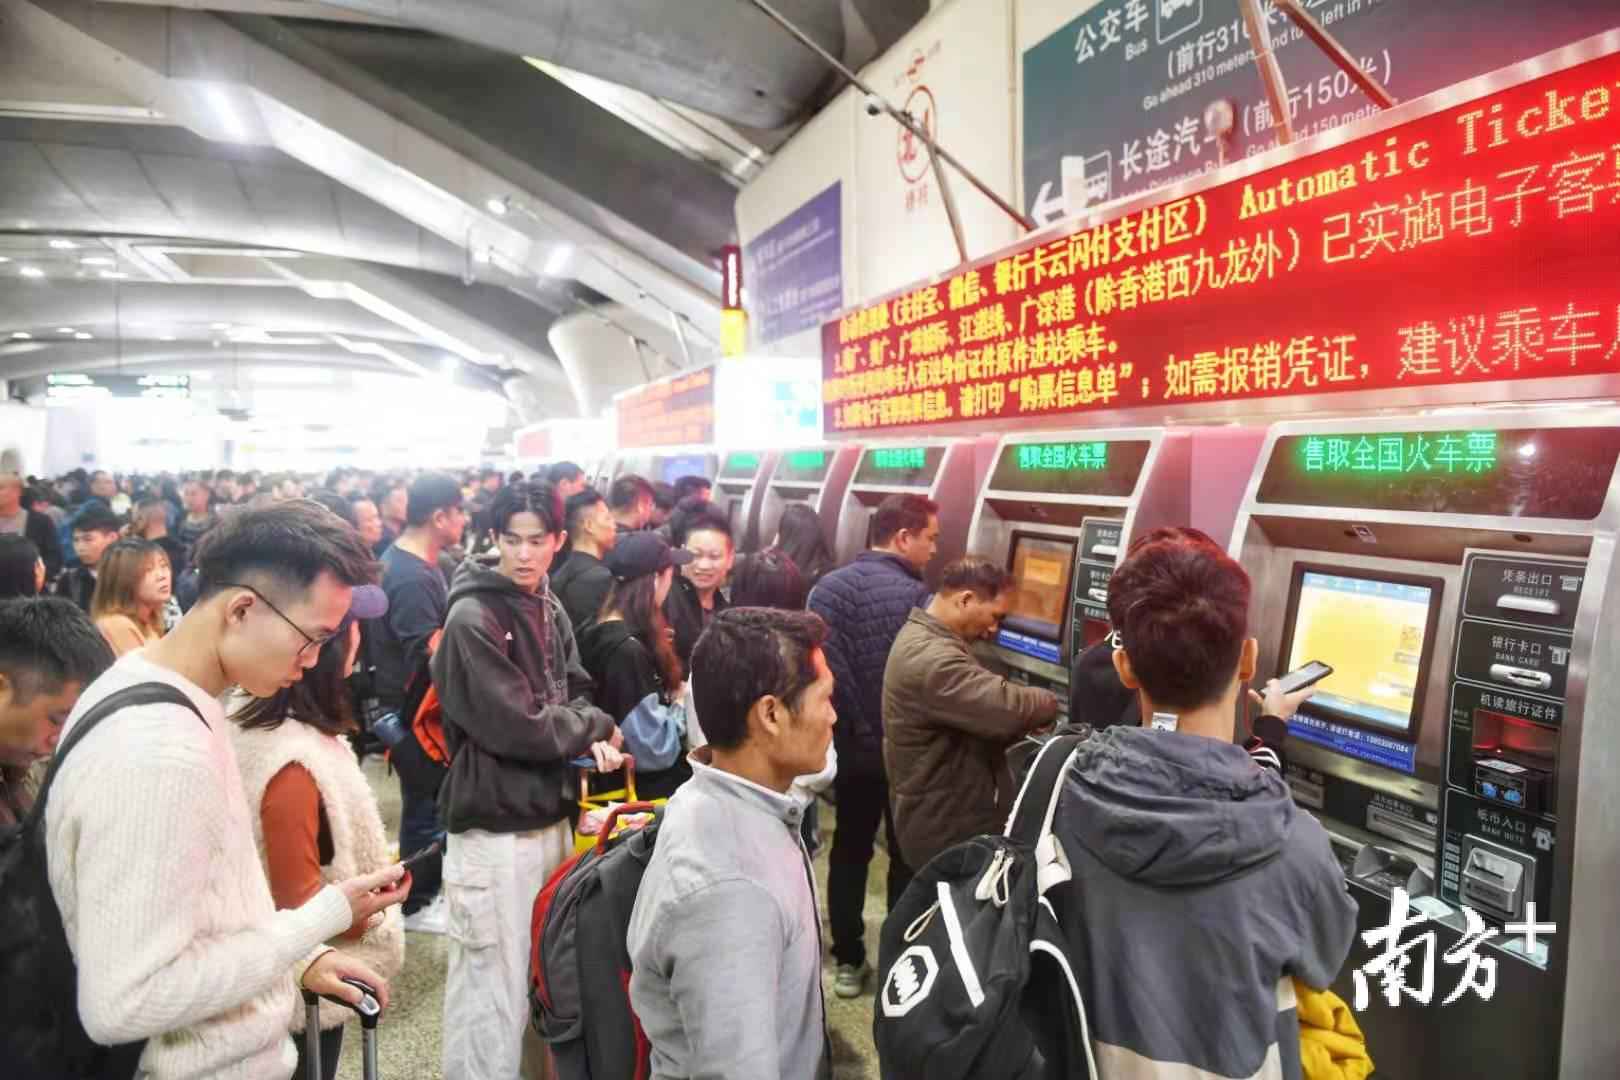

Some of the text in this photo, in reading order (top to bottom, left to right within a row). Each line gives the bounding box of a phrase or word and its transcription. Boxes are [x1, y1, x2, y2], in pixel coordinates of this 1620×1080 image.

[1074, 0, 1149, 64] 公交车
[1125, 38, 1148, 61] Bus
[1143, 95, 1158, 110] Go
[1160, 78, 1192, 103] ahead
[1194, 64, 1216, 88] 310
[1268, 27, 1288, 49] nd
[1320, 4, 1344, 26] left
[1119, 113, 1218, 181] 长途汽
[1239, 137, 1430, 219] Automatic
[1456, 82, 1620, 155] Ticke
[1303, 432, 1497, 473] 售取全国火车票
[1491, 635, 1542, 656] 银行卡口
[1495, 653, 1515, 664] BANK
[1480, 691, 1557, 720] 机读旅行证件
